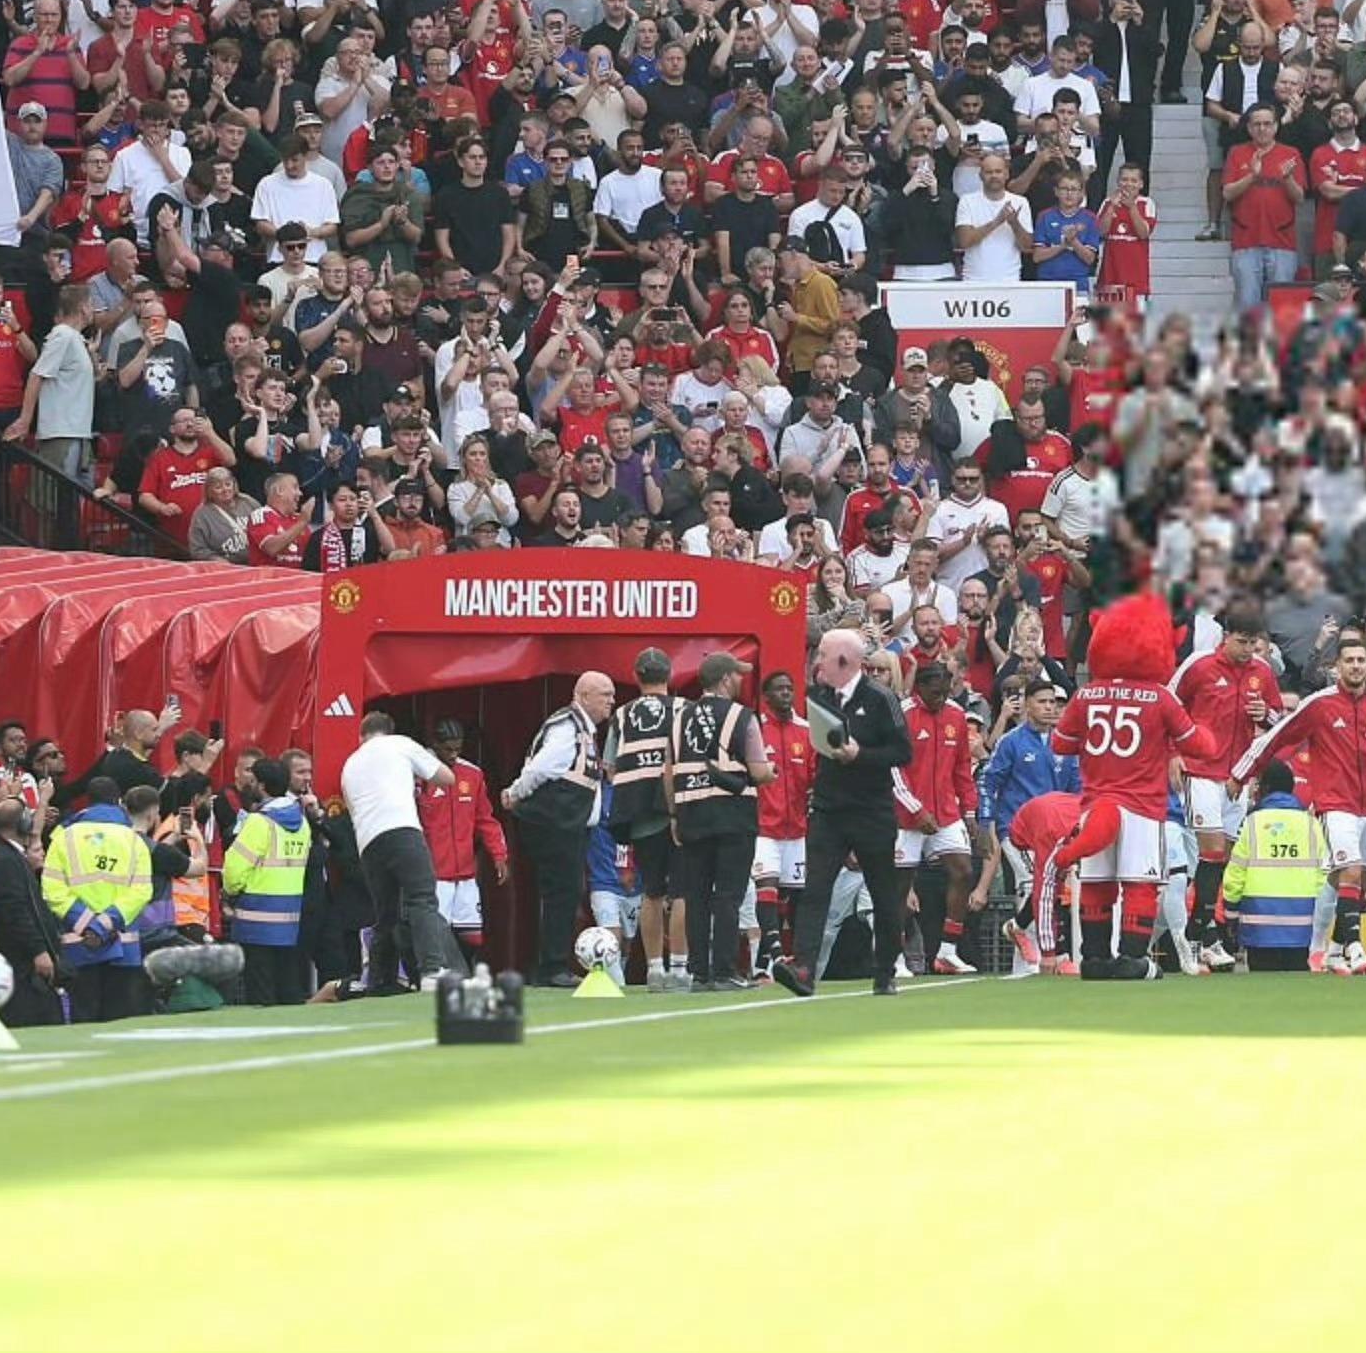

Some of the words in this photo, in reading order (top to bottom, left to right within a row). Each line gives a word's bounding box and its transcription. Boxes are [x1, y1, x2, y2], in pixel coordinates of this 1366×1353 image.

[944, 300, 1011, 318] W106
[445, 578, 608, 618] MANCHESTER
[612, 580, 697, 618] UNITED
[1077, 687, 1105, 700] FRED
[1109, 688, 1131, 700] THE
[1133, 689, 1158, 703] RED
[1085, 704, 1142, 758] 55
[1270, 844, 1299, 858] 376
